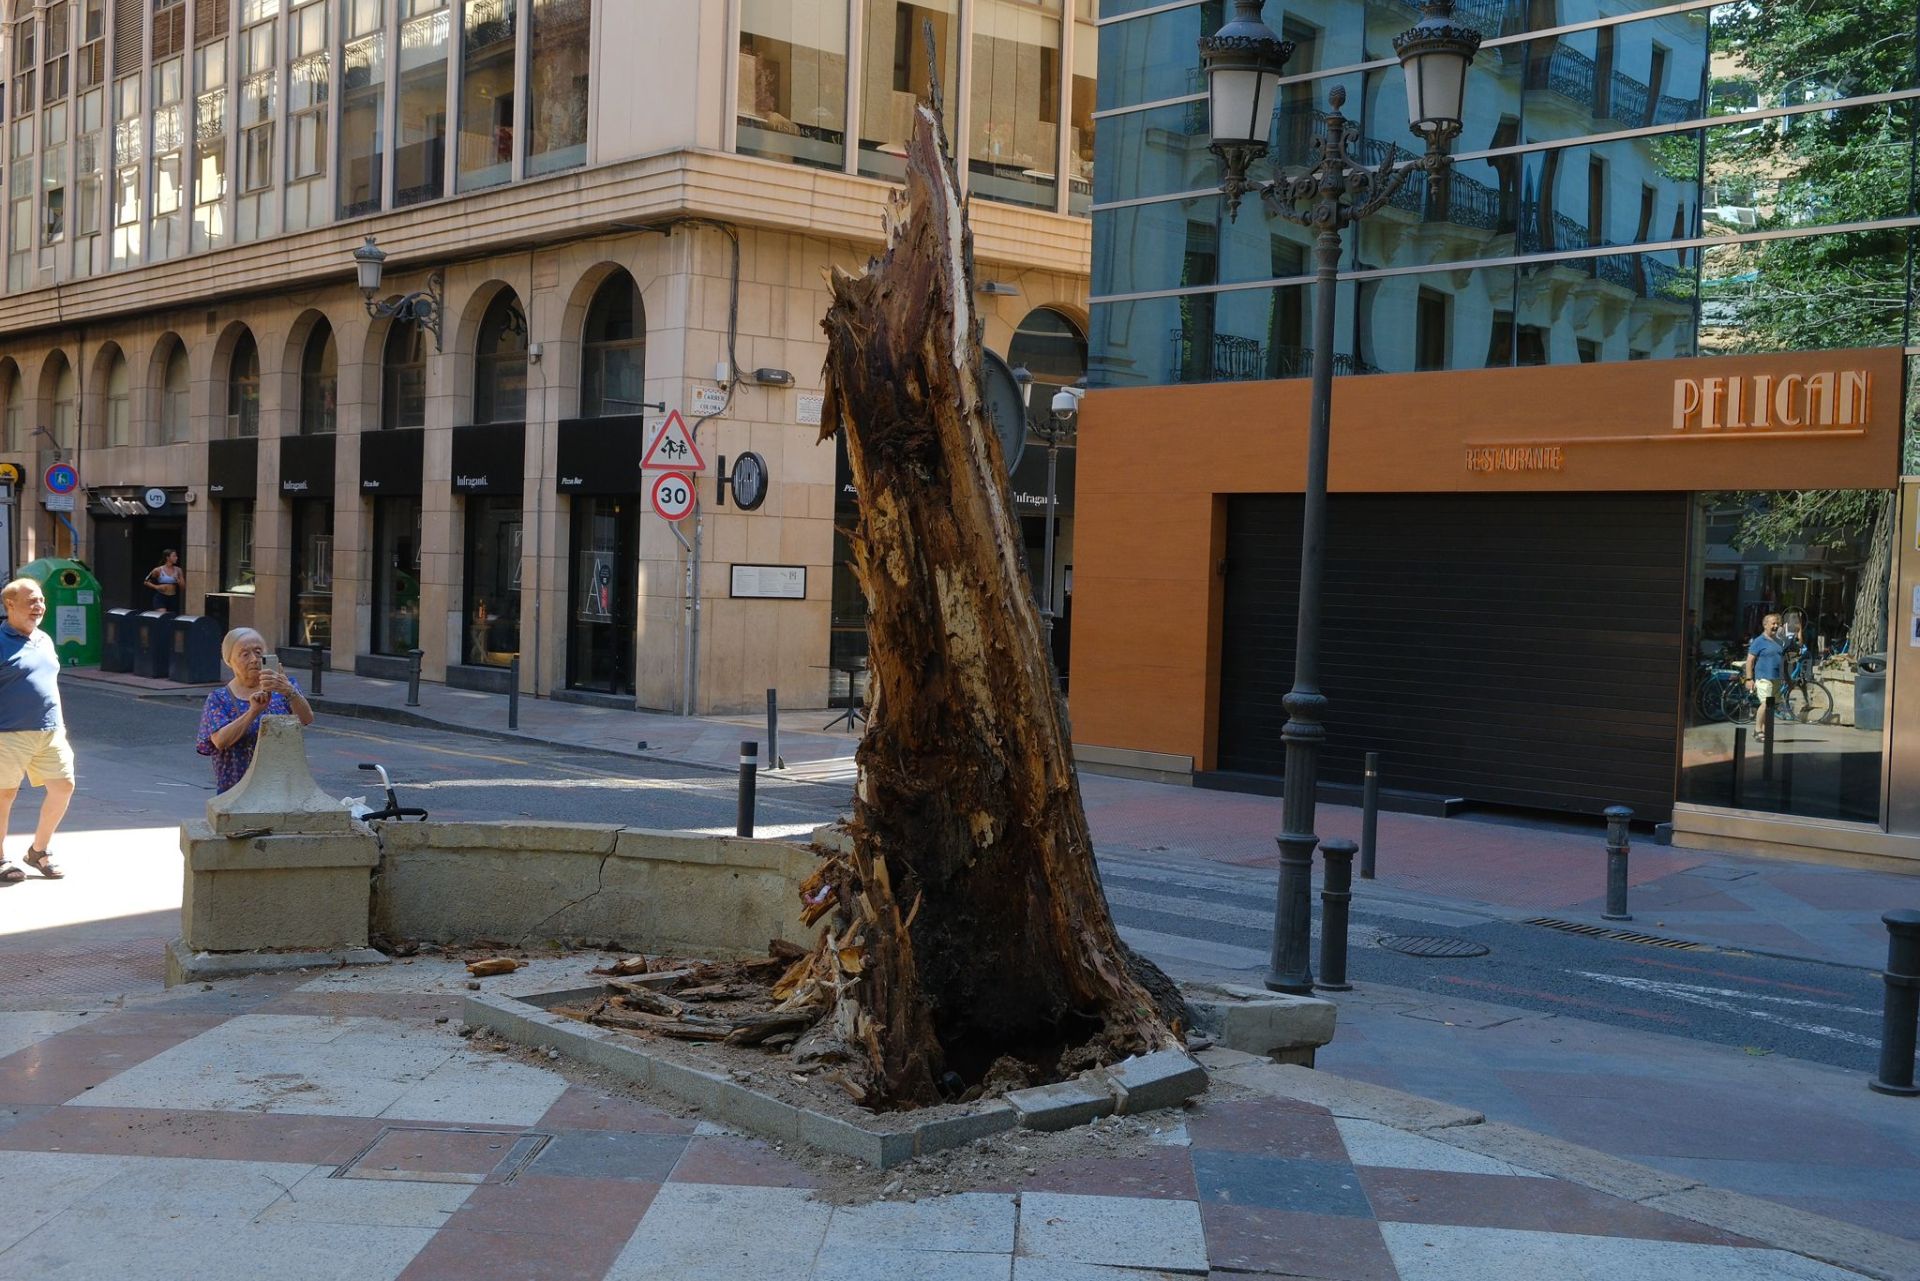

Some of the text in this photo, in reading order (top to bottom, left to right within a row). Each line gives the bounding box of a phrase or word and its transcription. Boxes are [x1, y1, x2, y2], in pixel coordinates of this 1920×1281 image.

[1673, 370, 1867, 429] PELICAN
[1465, 446, 1562, 472] RESTAURANTE
[660, 487, 687, 504] 30
